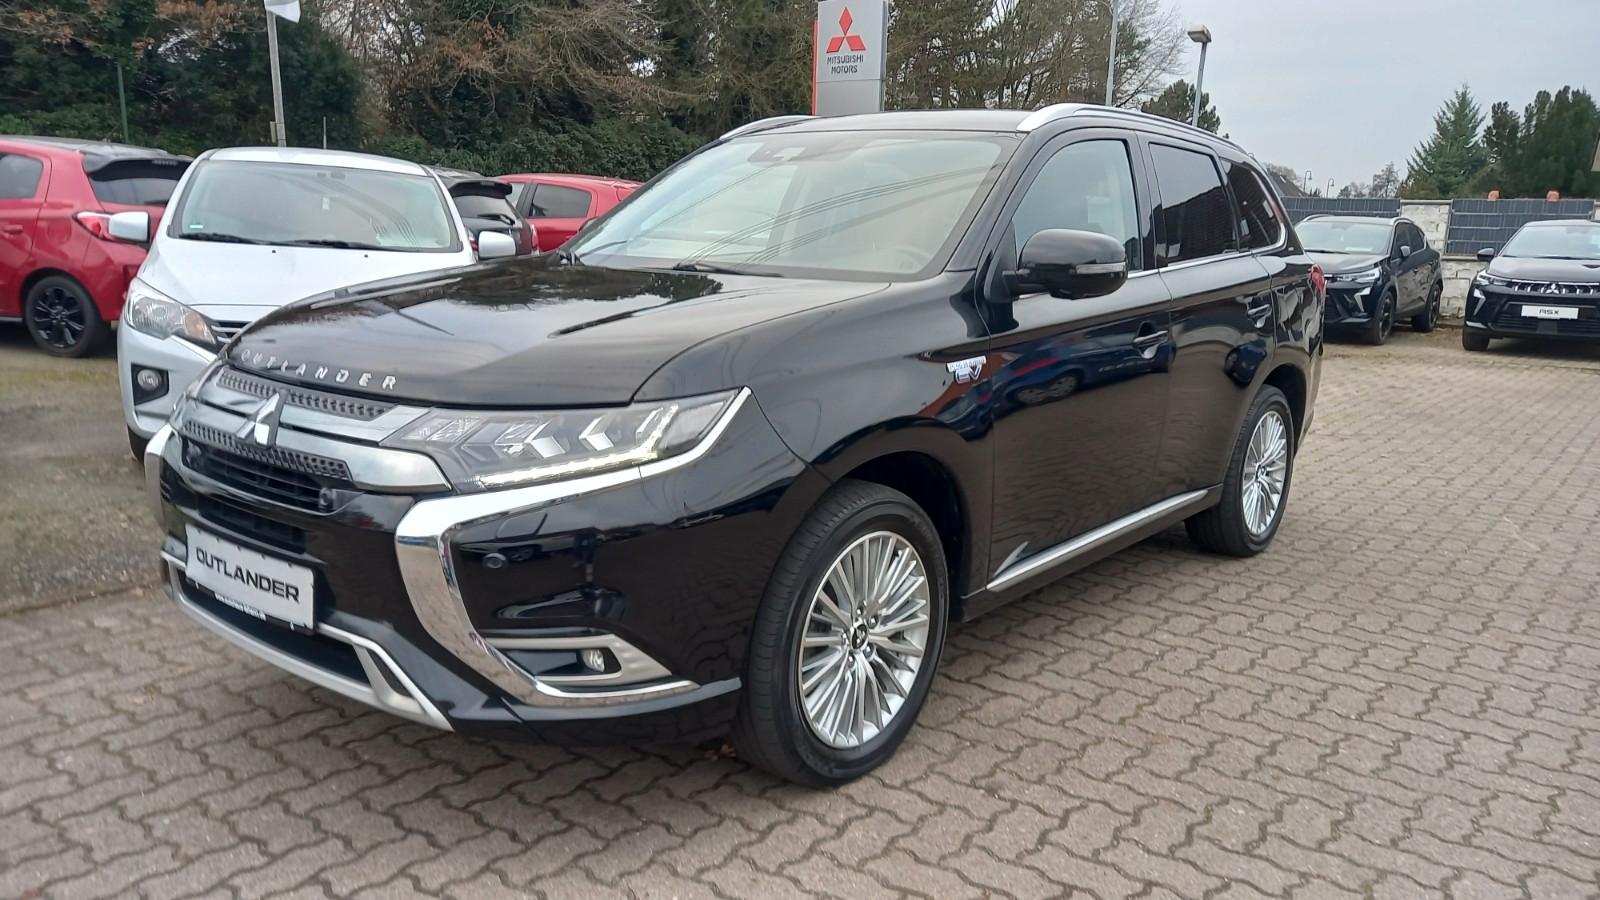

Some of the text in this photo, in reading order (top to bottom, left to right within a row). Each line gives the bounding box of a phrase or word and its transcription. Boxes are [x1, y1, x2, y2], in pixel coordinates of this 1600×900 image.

[827, 54, 864, 65] MITSUBISHI
[831, 65, 858, 74] MOTORS
[241, 349, 397, 391] OUTLANDER
[956, 363, 983, 384] EV
[196, 546, 300, 604] OUTLANDER
